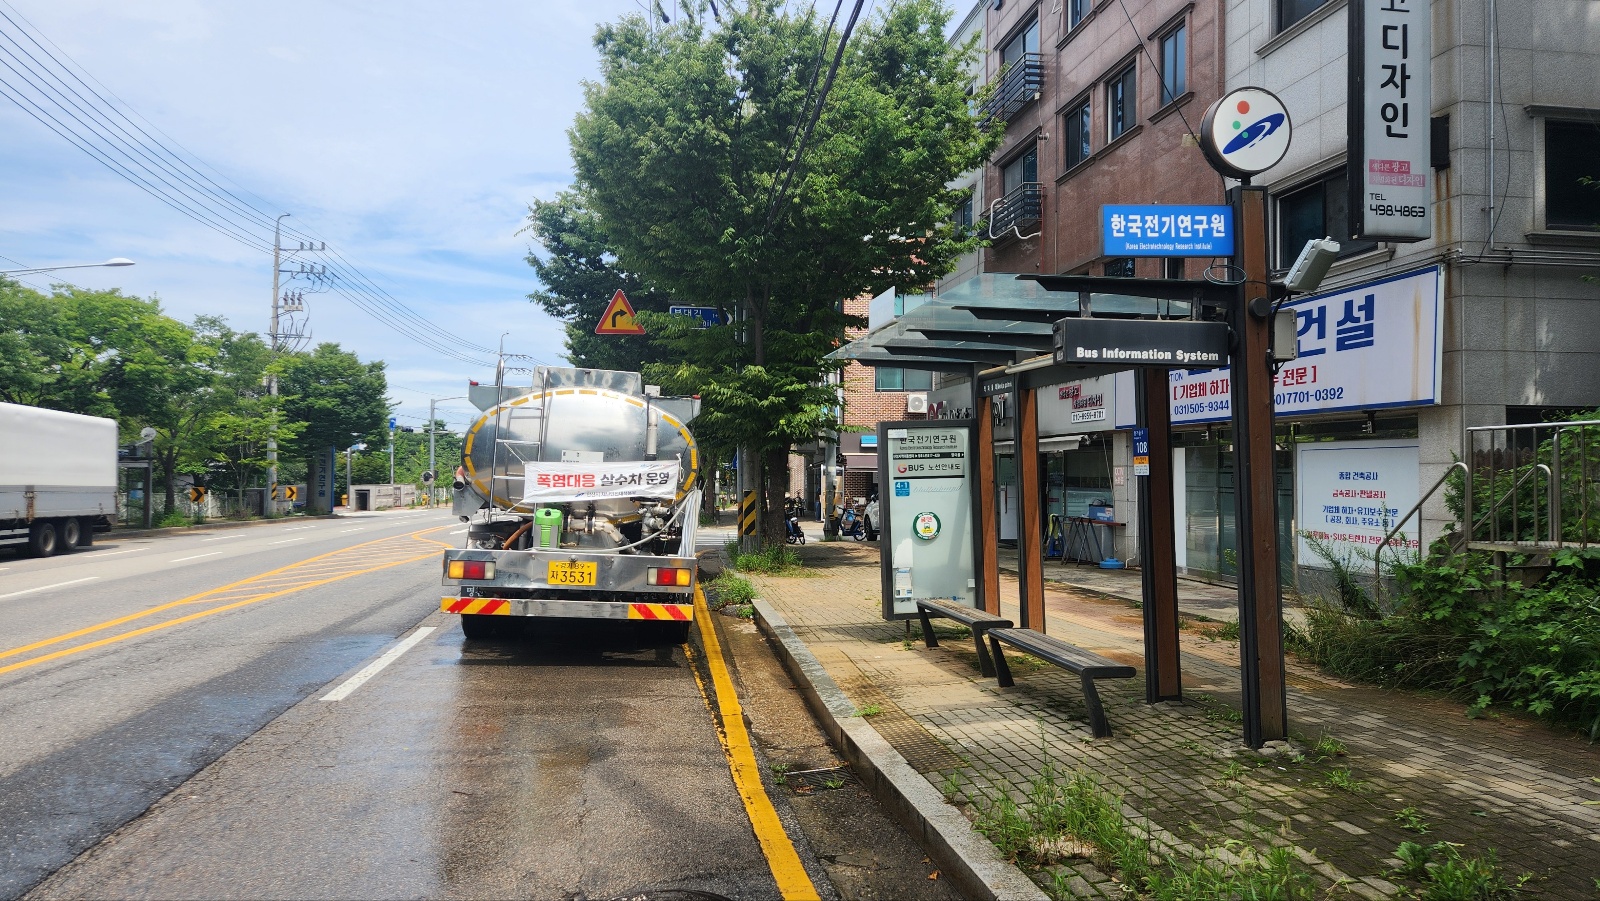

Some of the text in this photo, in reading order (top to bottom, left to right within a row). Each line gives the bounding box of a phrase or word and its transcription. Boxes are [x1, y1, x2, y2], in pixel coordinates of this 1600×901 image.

[1392, 161, 1409, 172] 광고
[1369, 192, 1387, 201] TEL
[1369, 203, 1426, 218] 498.4863
[1110, 213, 1226, 238] 한국전기연구원
[1297, 293, 1375, 358] 건설
[1076, 346, 1099, 359] Bus
[1102, 347, 1172, 360] Information
[1176, 349, 1219, 363] System
[1282, 366, 1308, 387] 전문
[1180, 382, 1207, 399] 기업체
[1210, 378, 1230, 395] 하자
[1174, 399, 1230, 416] 031)505-9344
[1136, 441, 1148, 454] 108
[537, 471, 670, 488] 폭염대응 살수차 운영
[1352, 471, 1378, 480] 건축공사
[1323, 505, 1340, 514] 기업체
